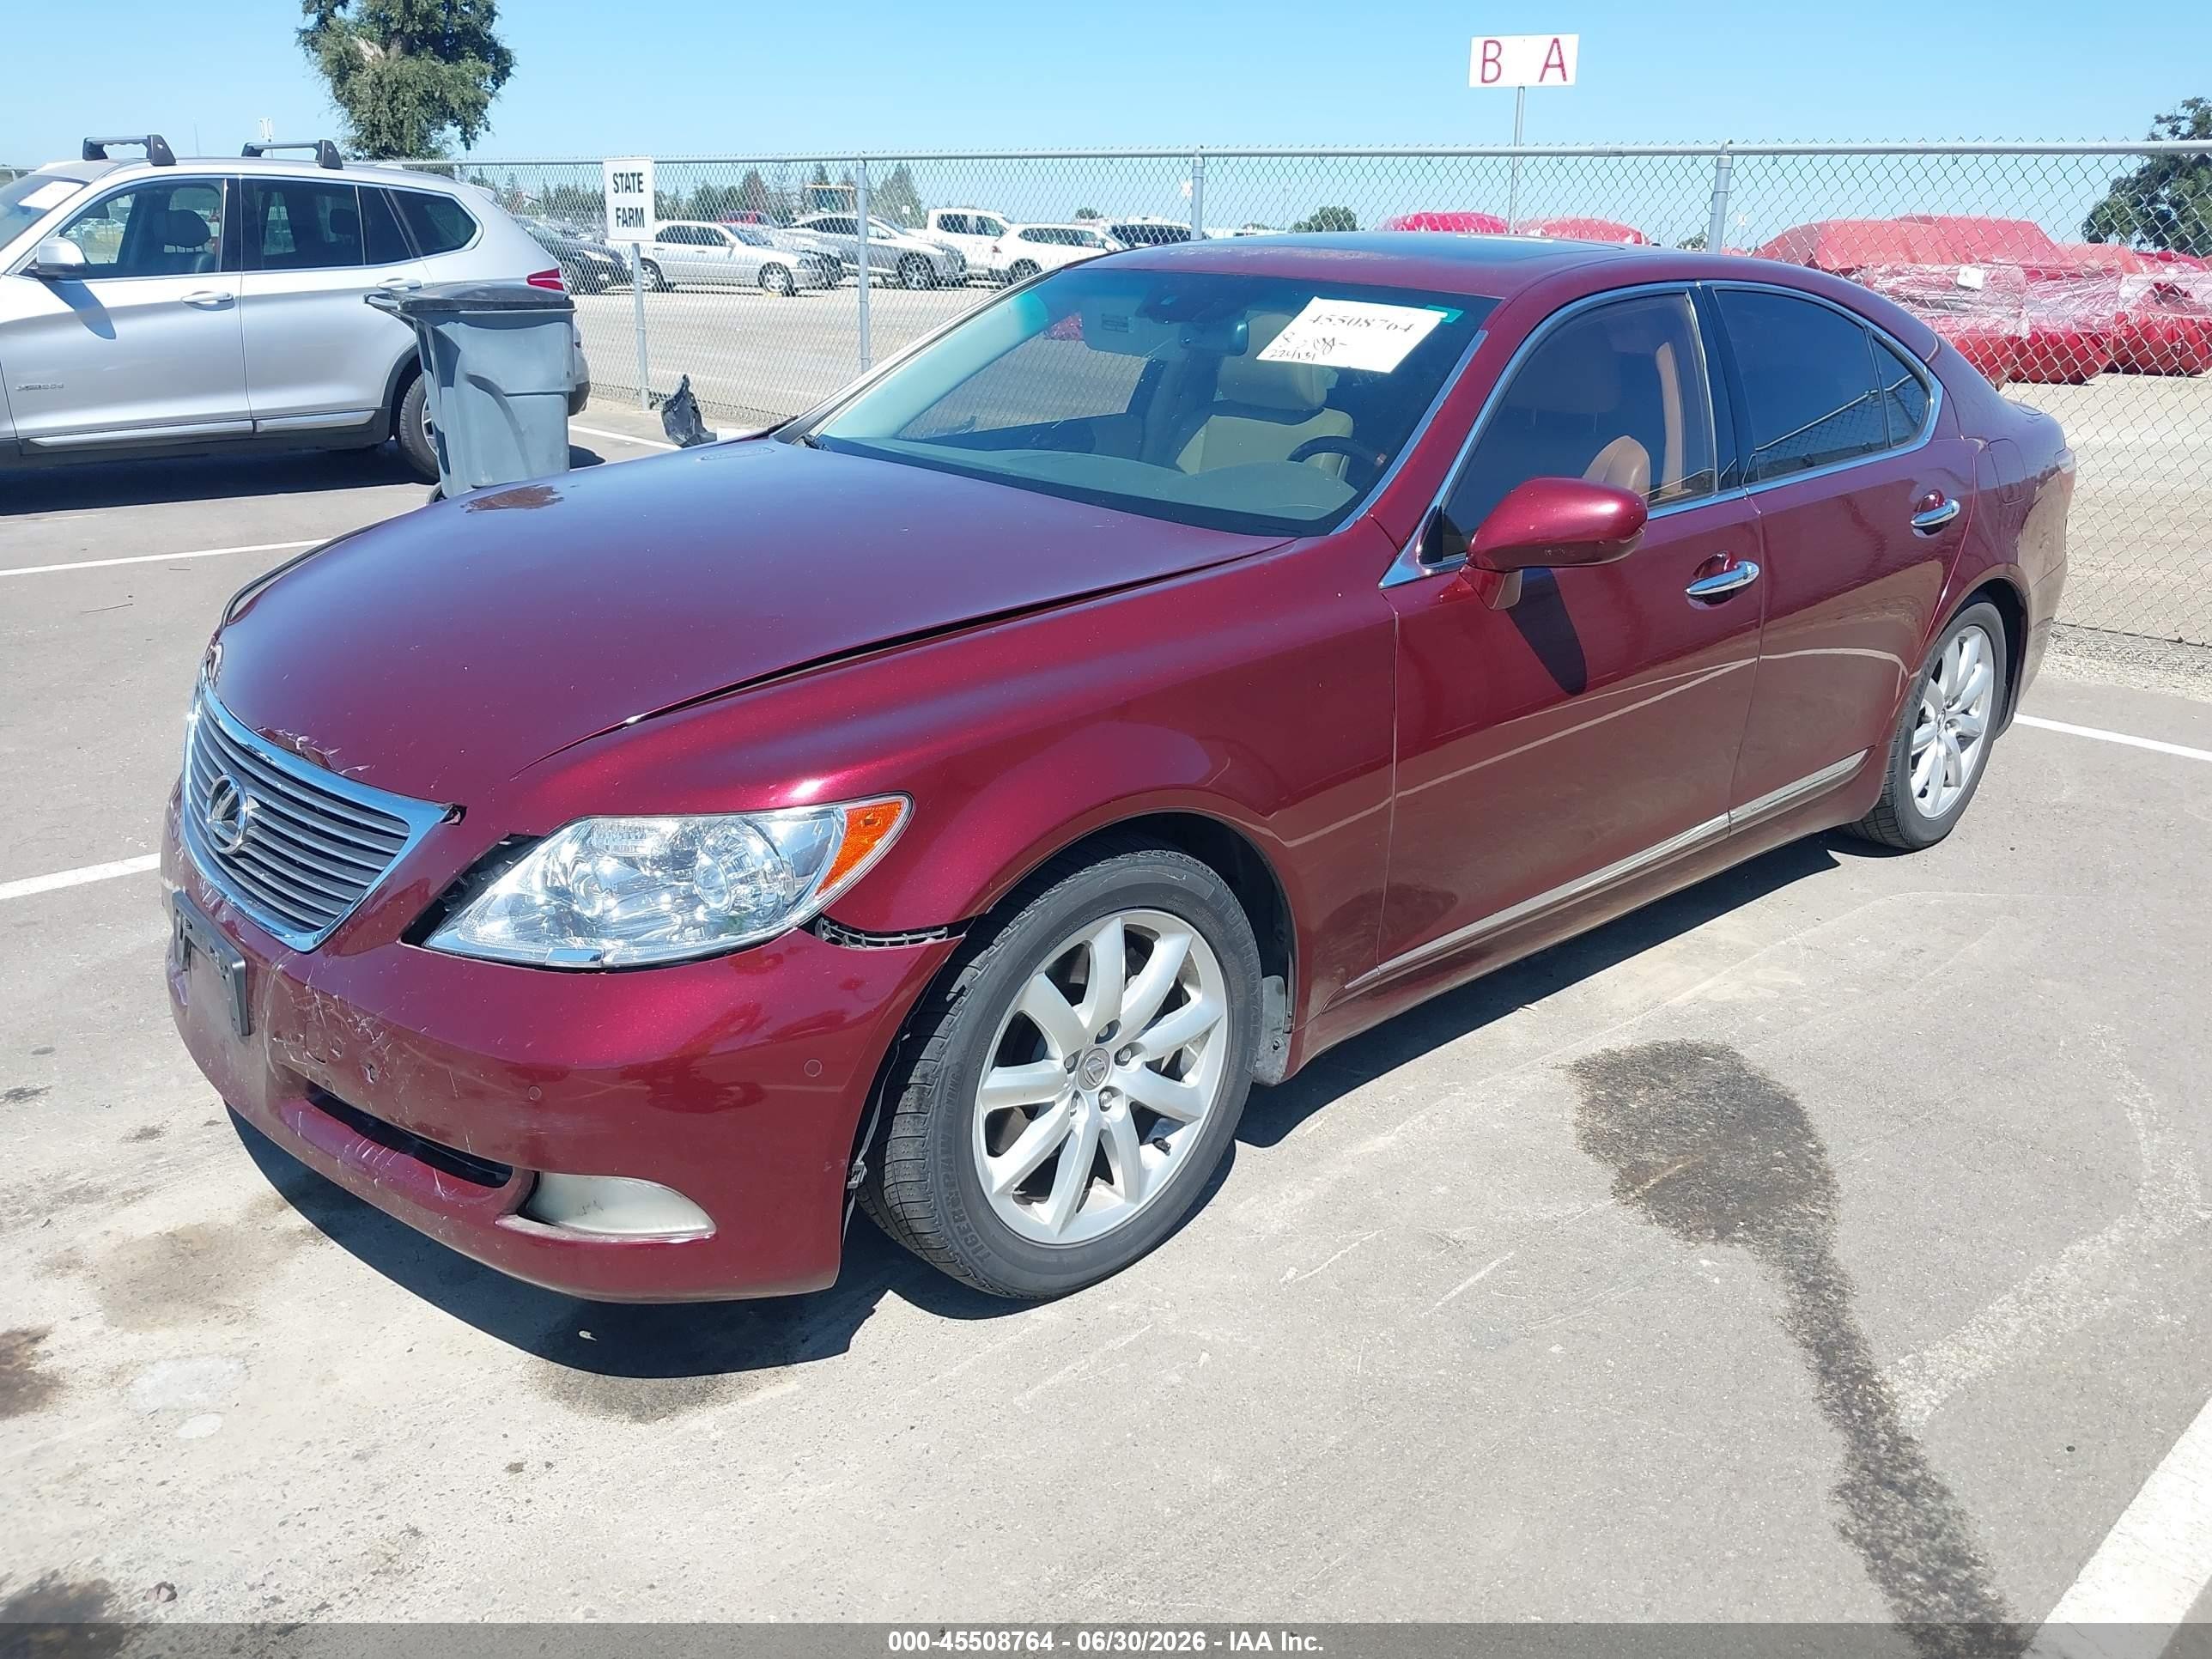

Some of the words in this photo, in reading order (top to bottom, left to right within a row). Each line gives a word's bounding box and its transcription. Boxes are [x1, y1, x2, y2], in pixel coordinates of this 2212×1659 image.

[1480, 40, 1502, 83] B
[1538, 38, 1567, 82] A
[612, 172, 644, 194] STATE
[615, 207, 645, 228] FARM
